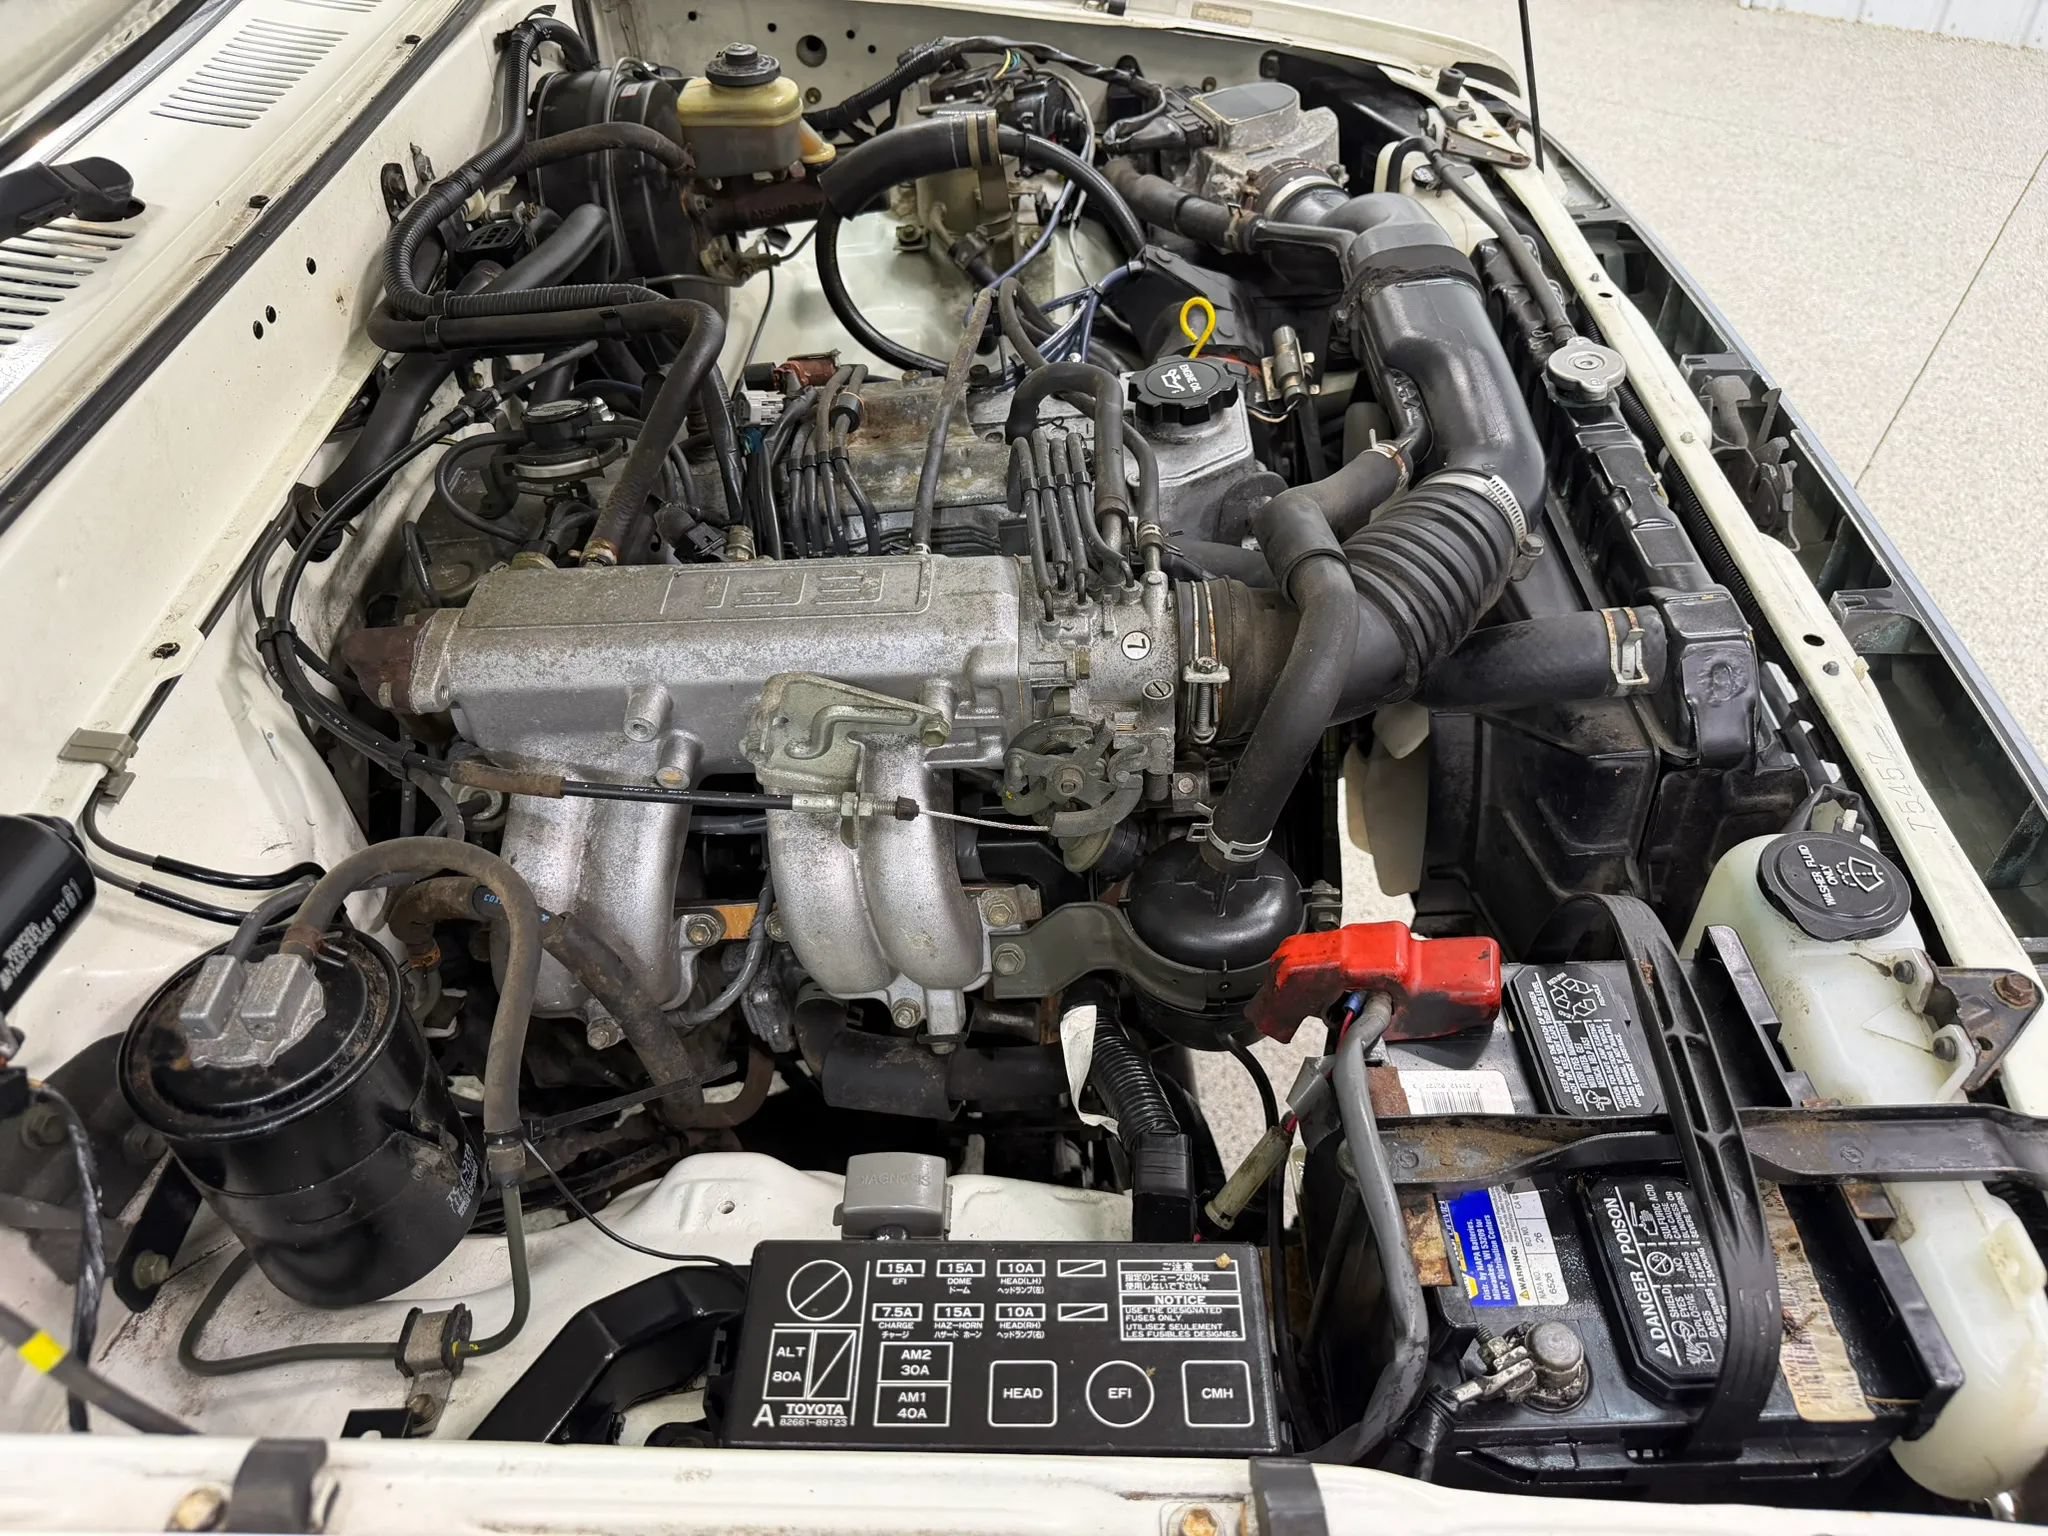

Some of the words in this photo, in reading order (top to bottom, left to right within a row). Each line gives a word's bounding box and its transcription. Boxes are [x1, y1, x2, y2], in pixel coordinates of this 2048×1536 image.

[1179, 363, 1197, 383] ENGINE
[1189, 381, 1202, 393] OIL
[1796, 844, 1818, 867] FLUID
[1818, 862, 1839, 885] ONLY
[1809, 870, 1838, 906] WASHER
[1592, 983, 1606, 1006] RECYCLE
[1580, 1036, 1592, 1049] FAST
[1586, 1050, 1597, 1064] HELP
[1592, 1065, 1606, 1087] MEDICAL
[1644, 1183, 1658, 1201] ACID
[1666, 1191, 1675, 1200] OR
[1675, 1191, 1688, 1212] BURNS
[1661, 1202, 1675, 1223] CAUSE
[1475, 1218, 1483, 1227] for
[1483, 1214, 1495, 1239] Centers
[1603, 1197, 1635, 1253] POISON
[1652, 1203, 1673, 1239] SULFURIC
[1671, 1203, 1690, 1238] BLINDNESS
[1683, 1213, 1699, 1238] SEVERE
[1534, 1232, 1544, 1243] 26
[1669, 1224, 1681, 1238] CAN
[1477, 1228, 1489, 1249] 53209
[1524, 1236, 1532, 1246] BCI
[1473, 1251, 1484, 1270] NAPA
[1483, 1249, 1491, 1260] WI
[1489, 1240, 1506, 1279] Distribution
[888, 1264, 913, 1273] 15A
[947, 1263, 973, 1273] 15A
[1008, 1264, 1034, 1273] 10A
[1162, 1262, 1194, 1271] ご注意
[1511, 1246, 1527, 1290] WARNING:
[1672, 1257, 1685, 1271] NO
[1681, 1251, 1698, 1278] SPARKS
[1690, 1251, 1706, 1278] FLAMES
[1697, 1247, 1715, 1277] SMOKING
[1478, 1271, 1488, 1280] by
[1545, 1272, 1557, 1294] 6526
[1480, 1281, 1492, 1300] Distr.
[1155, 1296, 1206, 1305] NOTICE
[1629, 1271, 1666, 1339] DANGER
[1661, 1288, 1680, 1317] SHIELD
[1674, 1295, 1691, 1317] EYES
[882, 1308, 912, 1317] 7.5A
[945, 1308, 971, 1317] 15A
[1007, 1307, 1033, 1317] 10A
[1684, 1292, 1709, 1337] EXPLOSIVE
[1701, 1310, 1719, 1337] GASES
[882, 1331, 909, 1339] チャージ
[776, 1346, 806, 1357] ALT
[901, 1350, 932, 1360] AM2
[773, 1371, 802, 1382] 80A
[901, 1365, 929, 1375] 30A
[898, 1392, 926, 1402] AM1
[1003, 1388, 1043, 1399] HEAD
[1108, 1388, 1132, 1399] EFI
[1201, 1388, 1234, 1399] CMH
[753, 1404, 774, 1427] A
[786, 1404, 844, 1415] TOYOTA
[897, 1408, 927, 1418] 40A
[779, 1418, 847, 1426] 82661-89123
